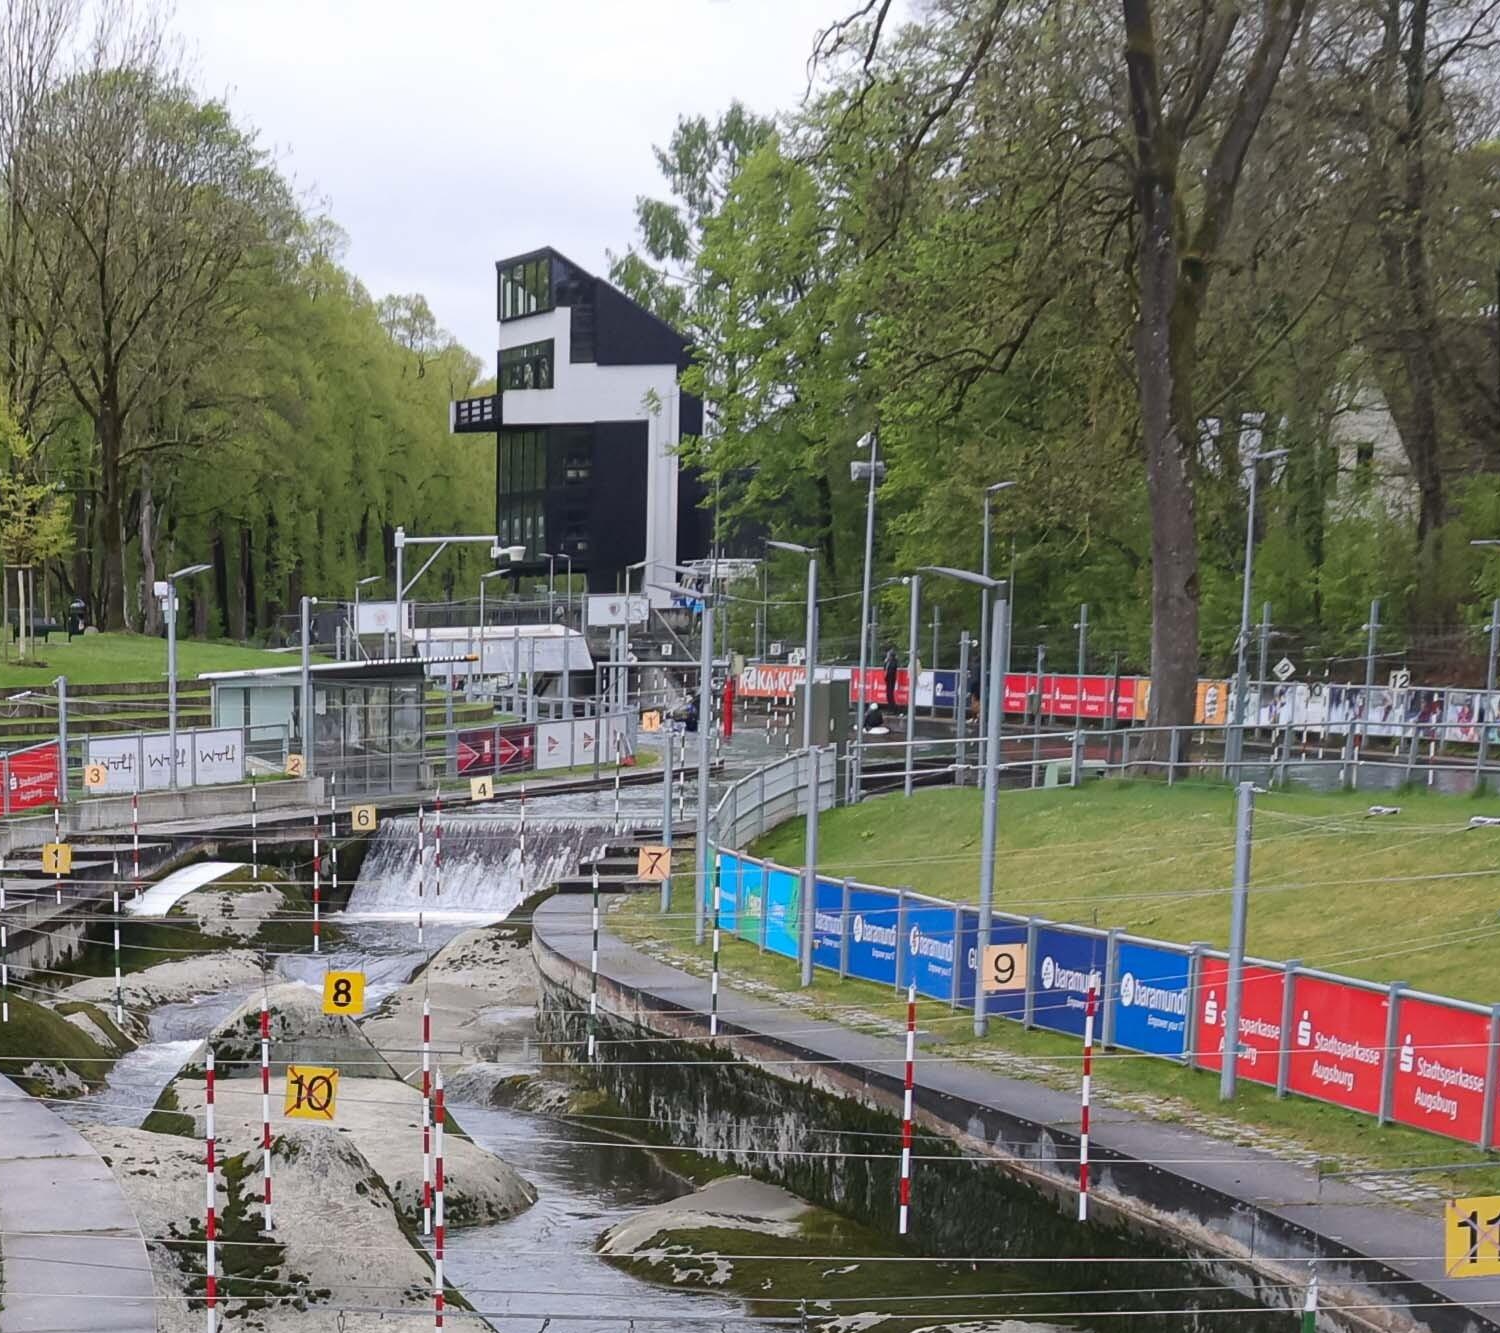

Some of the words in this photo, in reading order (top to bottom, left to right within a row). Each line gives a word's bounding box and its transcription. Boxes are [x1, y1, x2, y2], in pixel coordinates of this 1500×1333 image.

[1391, 674, 1409, 688] 12
[89, 768, 100, 783] 3
[291, 758, 301, 773] 2
[477, 783, 488, 797] 4
[357, 809, 369, 827] 6
[52, 848, 59, 869] 1
[649, 852, 662, 874] 7
[993, 953, 1015, 984] 9
[1054, 962, 1102, 996] baramui
[333, 978, 352, 1007] 8
[1134, 979, 1187, 1015] baramundi
[1220, 1010, 1280, 1039] Ssparkasse
[1315, 1031, 1380, 1065] Stadtsparkasse
[1312, 1059, 1354, 1092] Augsburg
[1416, 1056, 1484, 1093] Stadtsparkasse
[291, 1073, 333, 1112] 10
[1414, 1087, 1457, 1121] Augsburg
